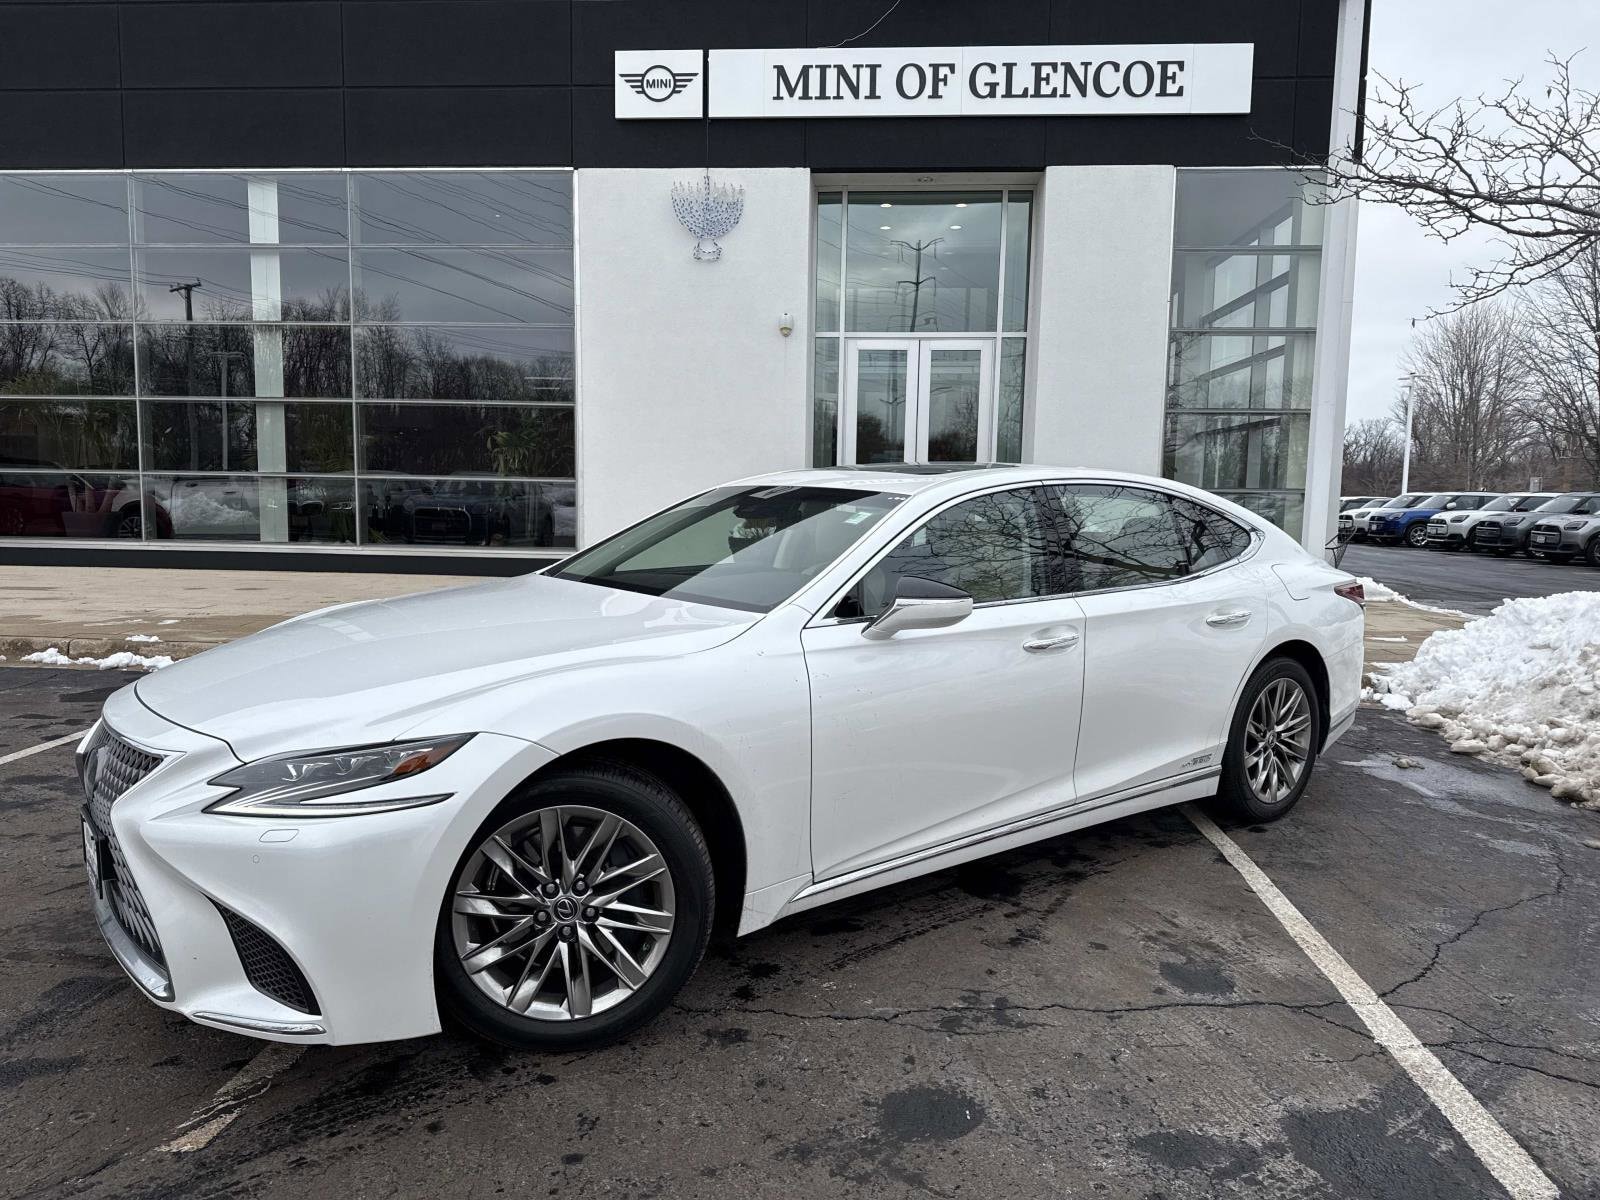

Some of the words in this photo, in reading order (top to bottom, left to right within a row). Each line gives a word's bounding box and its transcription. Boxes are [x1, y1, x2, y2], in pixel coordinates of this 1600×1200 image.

[645, 79, 672, 89] MINI
[772, 64, 882, 101] MINI
[895, 62, 956, 100] OF
[968, 60, 1185, 100] GLENCOE
